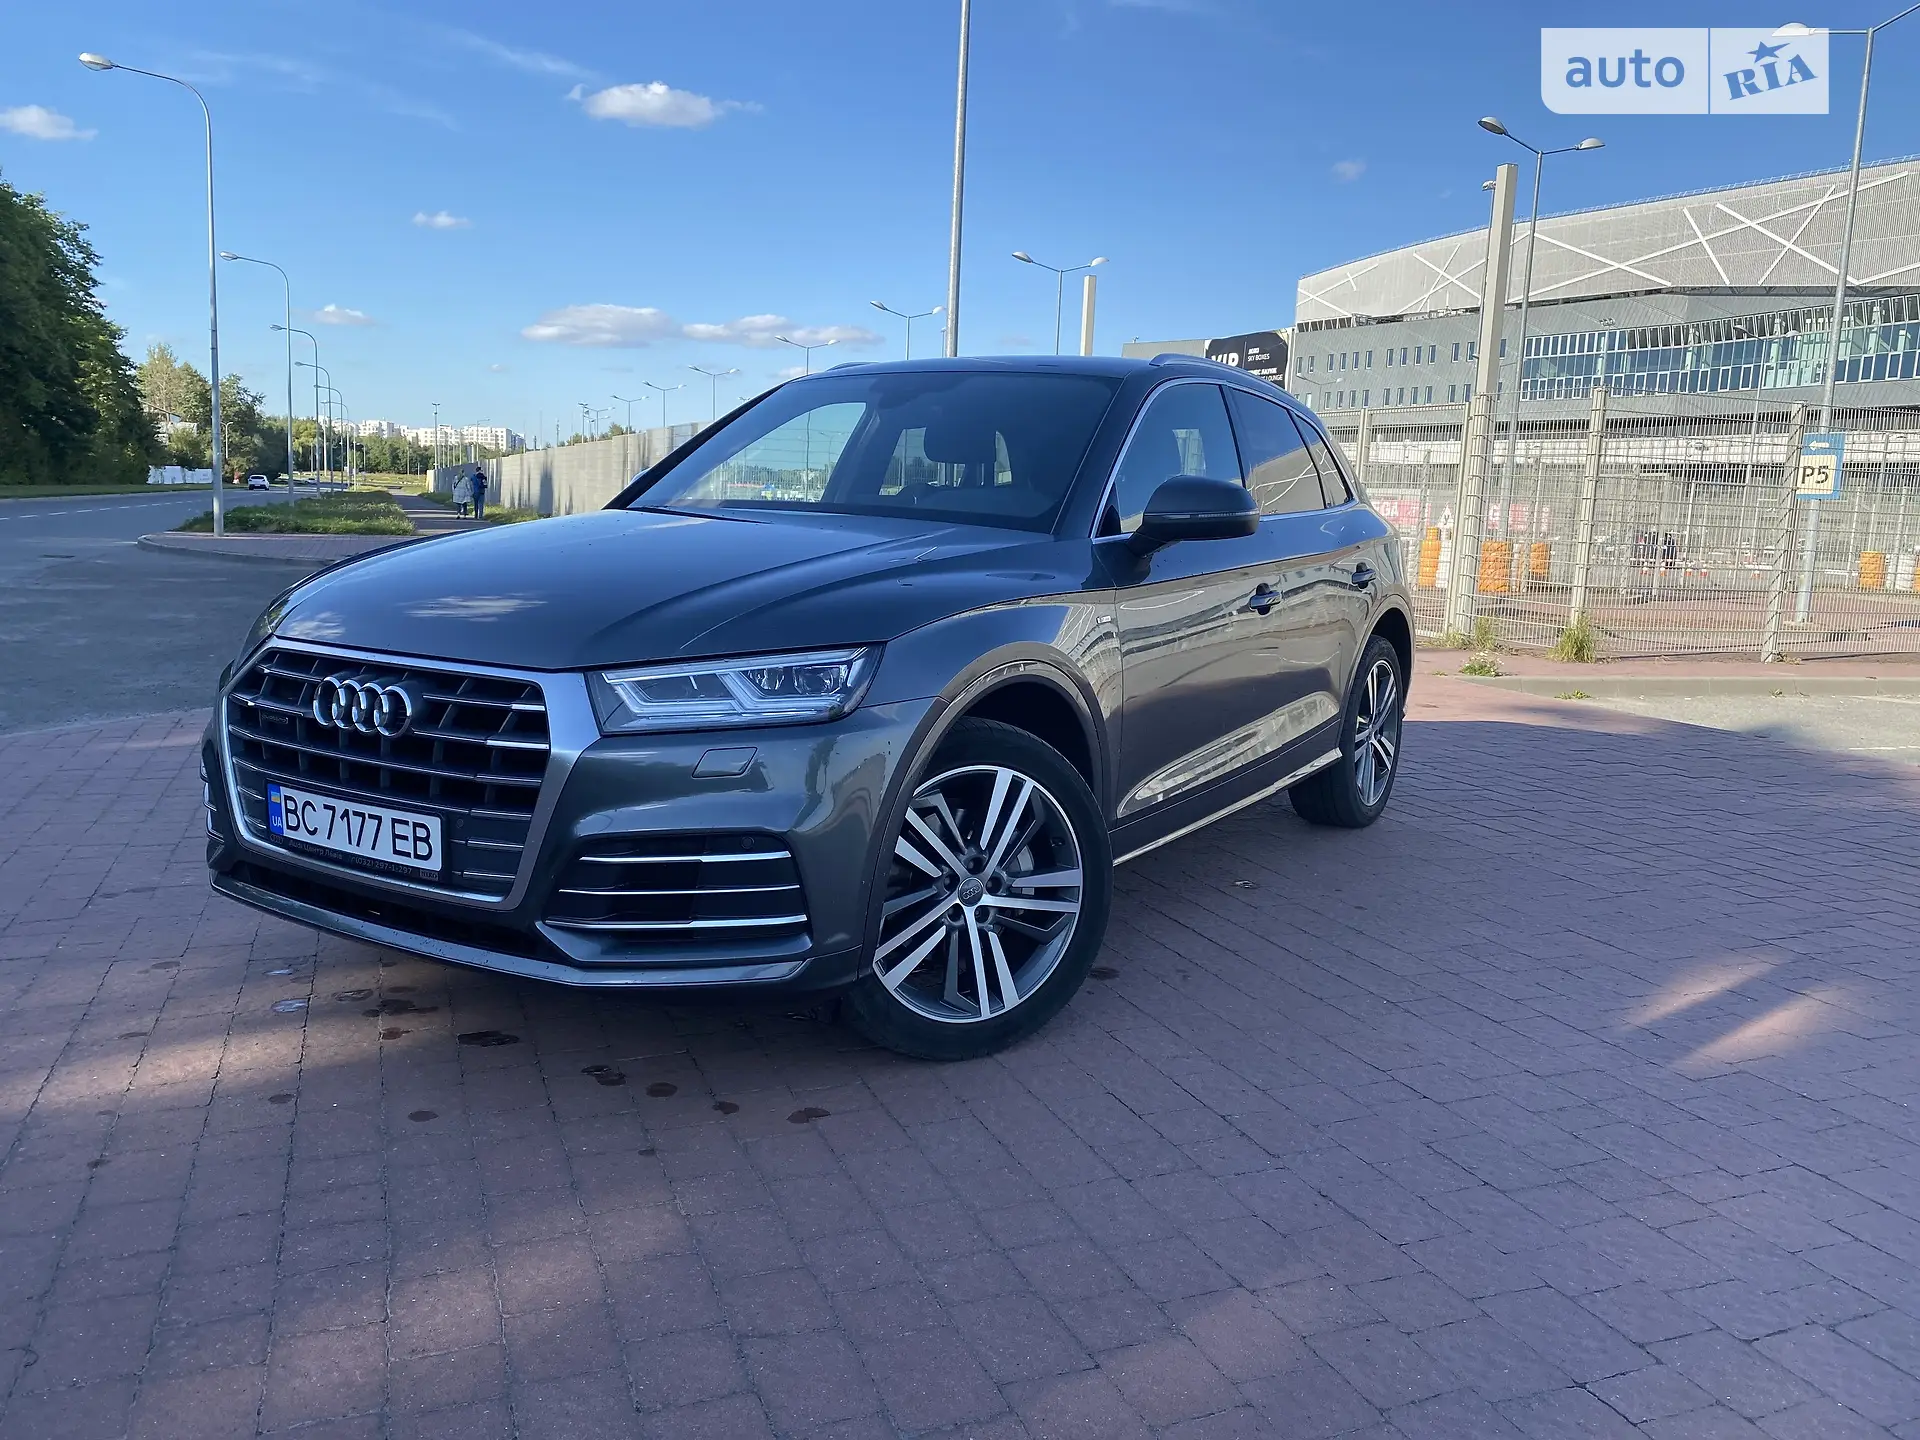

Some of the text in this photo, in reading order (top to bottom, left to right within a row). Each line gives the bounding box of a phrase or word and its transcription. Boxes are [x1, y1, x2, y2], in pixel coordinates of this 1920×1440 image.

[1801, 465, 1829, 485] P5
[272, 815, 283, 828] UA
[284, 794, 433, 861] BC 7177 EB
